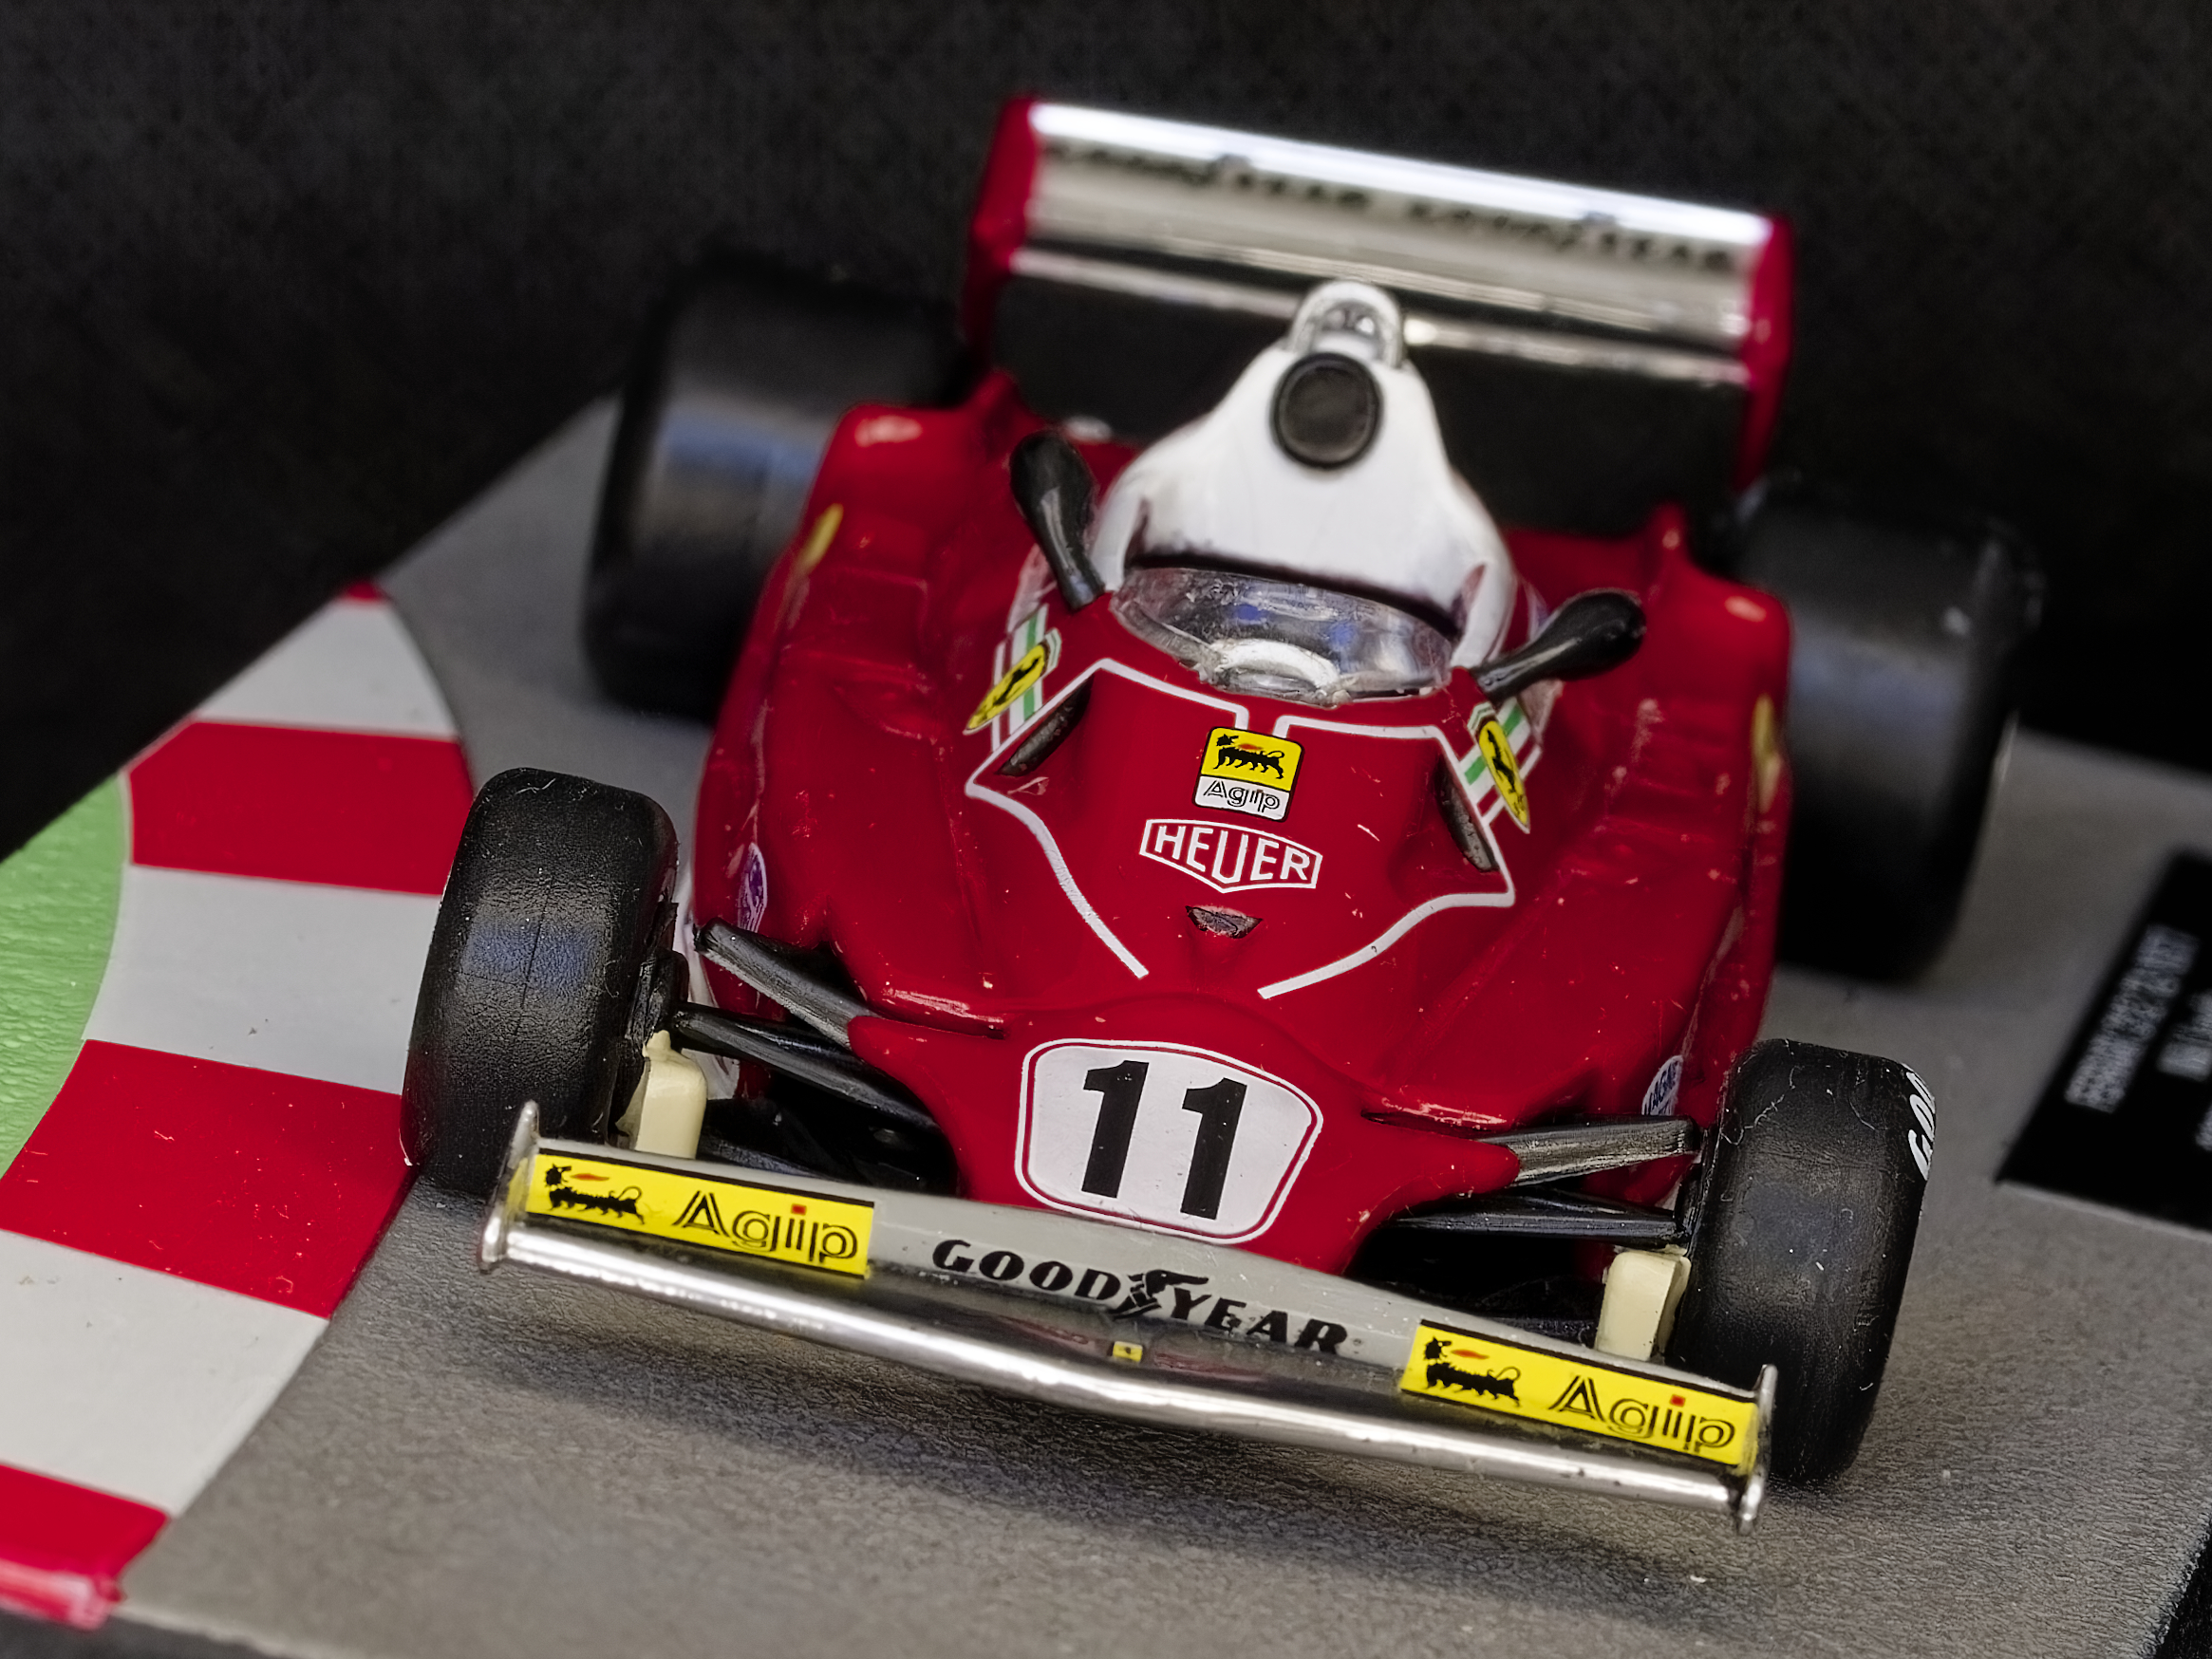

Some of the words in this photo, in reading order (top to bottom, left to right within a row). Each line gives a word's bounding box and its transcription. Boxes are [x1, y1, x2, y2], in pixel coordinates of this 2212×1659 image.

[1203, 780, 1281, 813] Agip
[1154, 825, 1310, 884] HEUER
[1081, 1060, 1247, 1220] 11
[672, 1189, 858, 1264] Agip
[931, 1238, 1349, 1355] GOODYEAR
[1547, 1374, 1736, 1452] Agip
